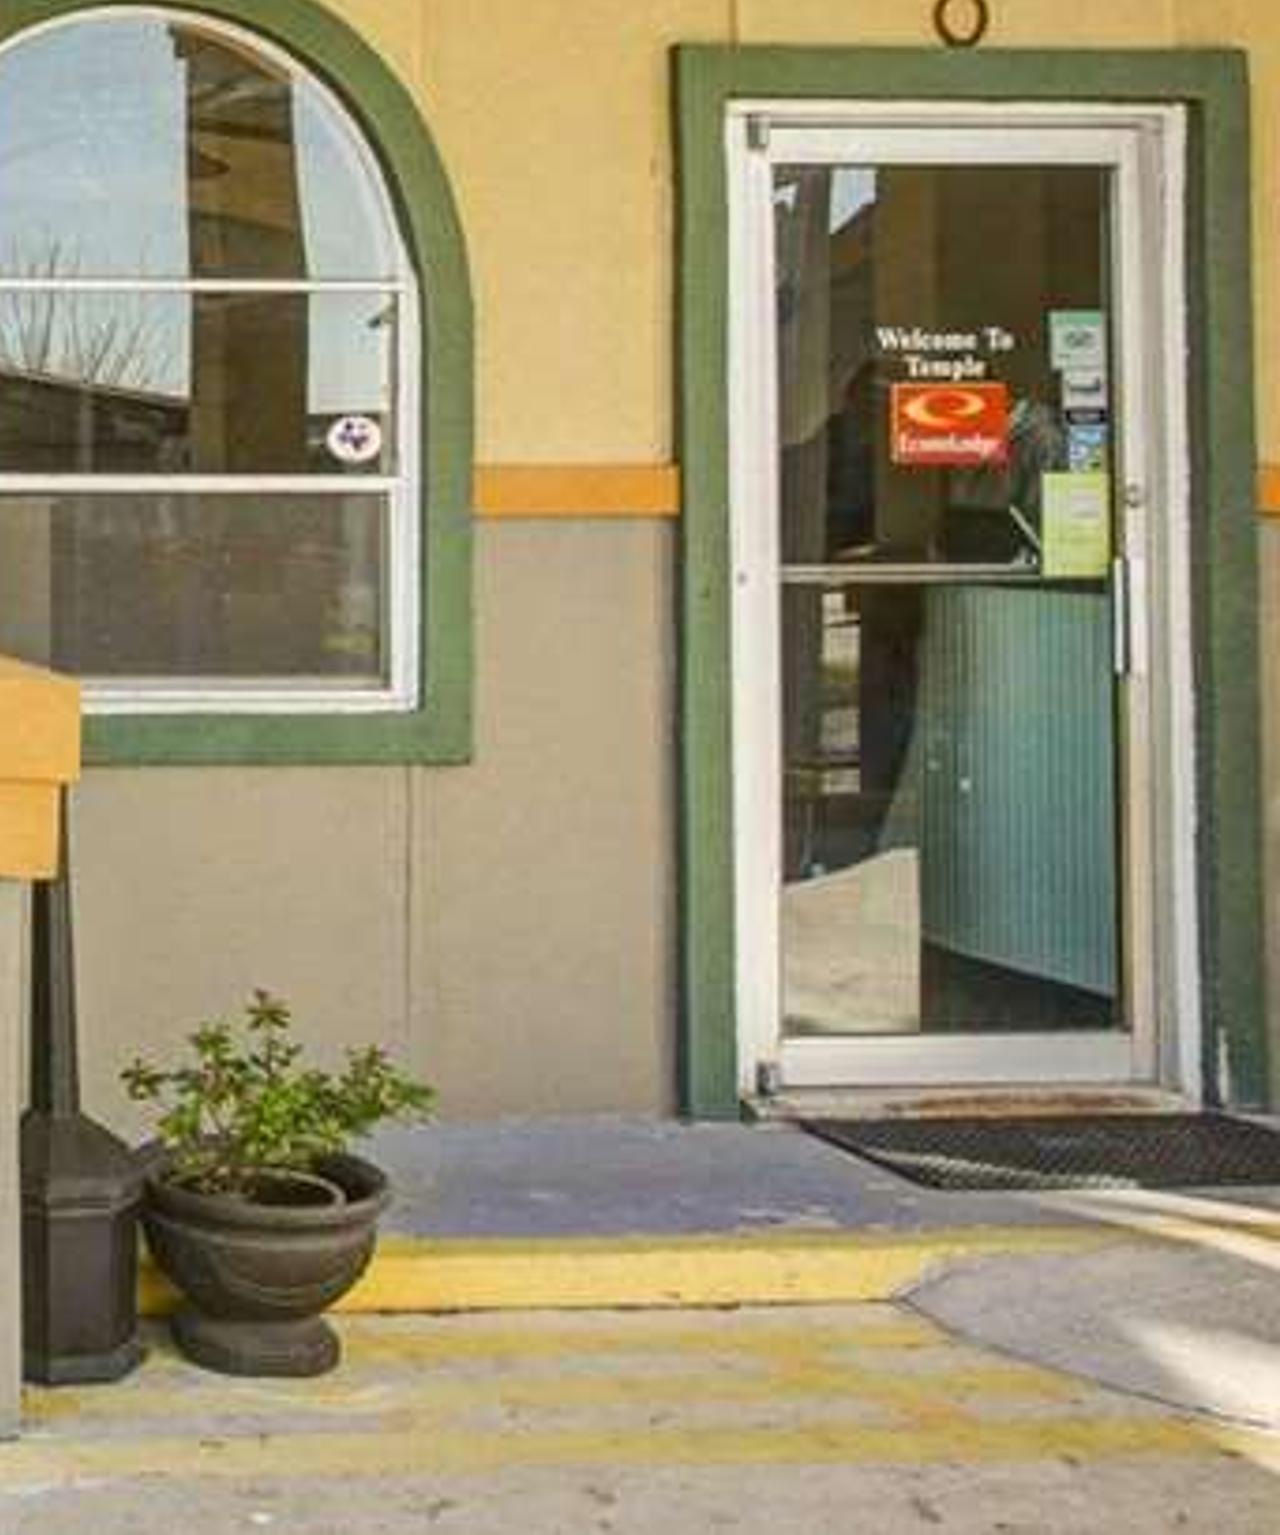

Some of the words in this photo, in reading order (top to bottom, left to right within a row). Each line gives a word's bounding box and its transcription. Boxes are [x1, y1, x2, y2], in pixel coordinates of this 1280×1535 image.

[876, 326, 978, 350] Welcome
[982, 326, 1015, 351] To
[903, 353, 986, 381] Temple
